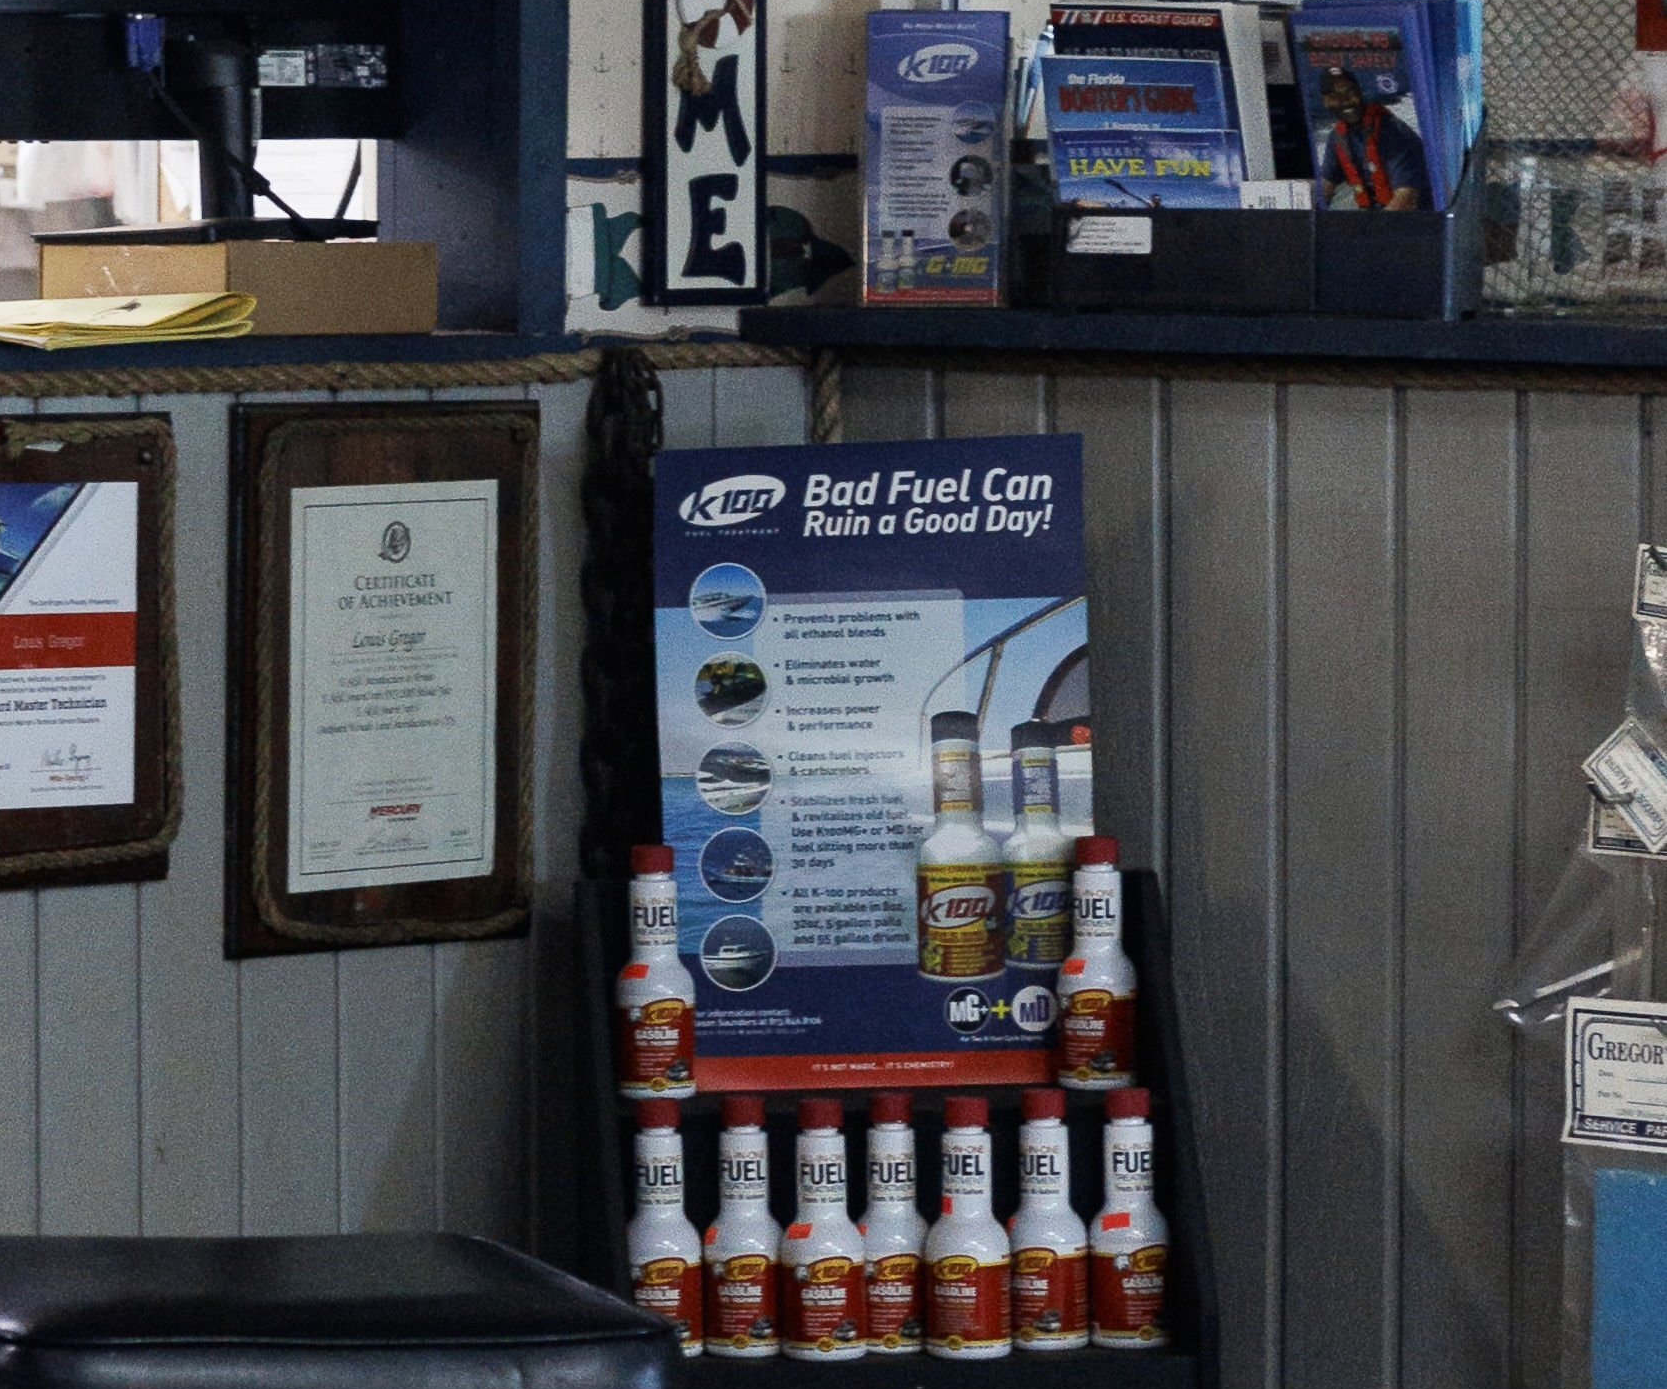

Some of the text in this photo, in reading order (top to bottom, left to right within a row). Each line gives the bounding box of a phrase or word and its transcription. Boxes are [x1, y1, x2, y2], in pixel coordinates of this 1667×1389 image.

[1069, 158, 1212, 178] HAVE FUN
[803, 466, 1054, 508] Bad Fuel Can
[803, 502, 1053, 538] Ruin a Good Day!
[353, 573, 436, 591] CERTIFICATE
[337, 590, 453, 611] OF ACHIEVEMENT
[783, 614, 835, 625] Prevents
[838, 611, 893, 625] problems
[633, 905, 678, 928] FUEL
[1019, 994, 1051, 1024] MD
[1583, 1117, 1637, 1136] SERVICE
[870, 1162, 917, 1184] FUEL
[1112, 1151, 1152, 1173] FUE
[636, 1164, 681, 1187] FUEL
[801, 1163, 846, 1185] FUEL
